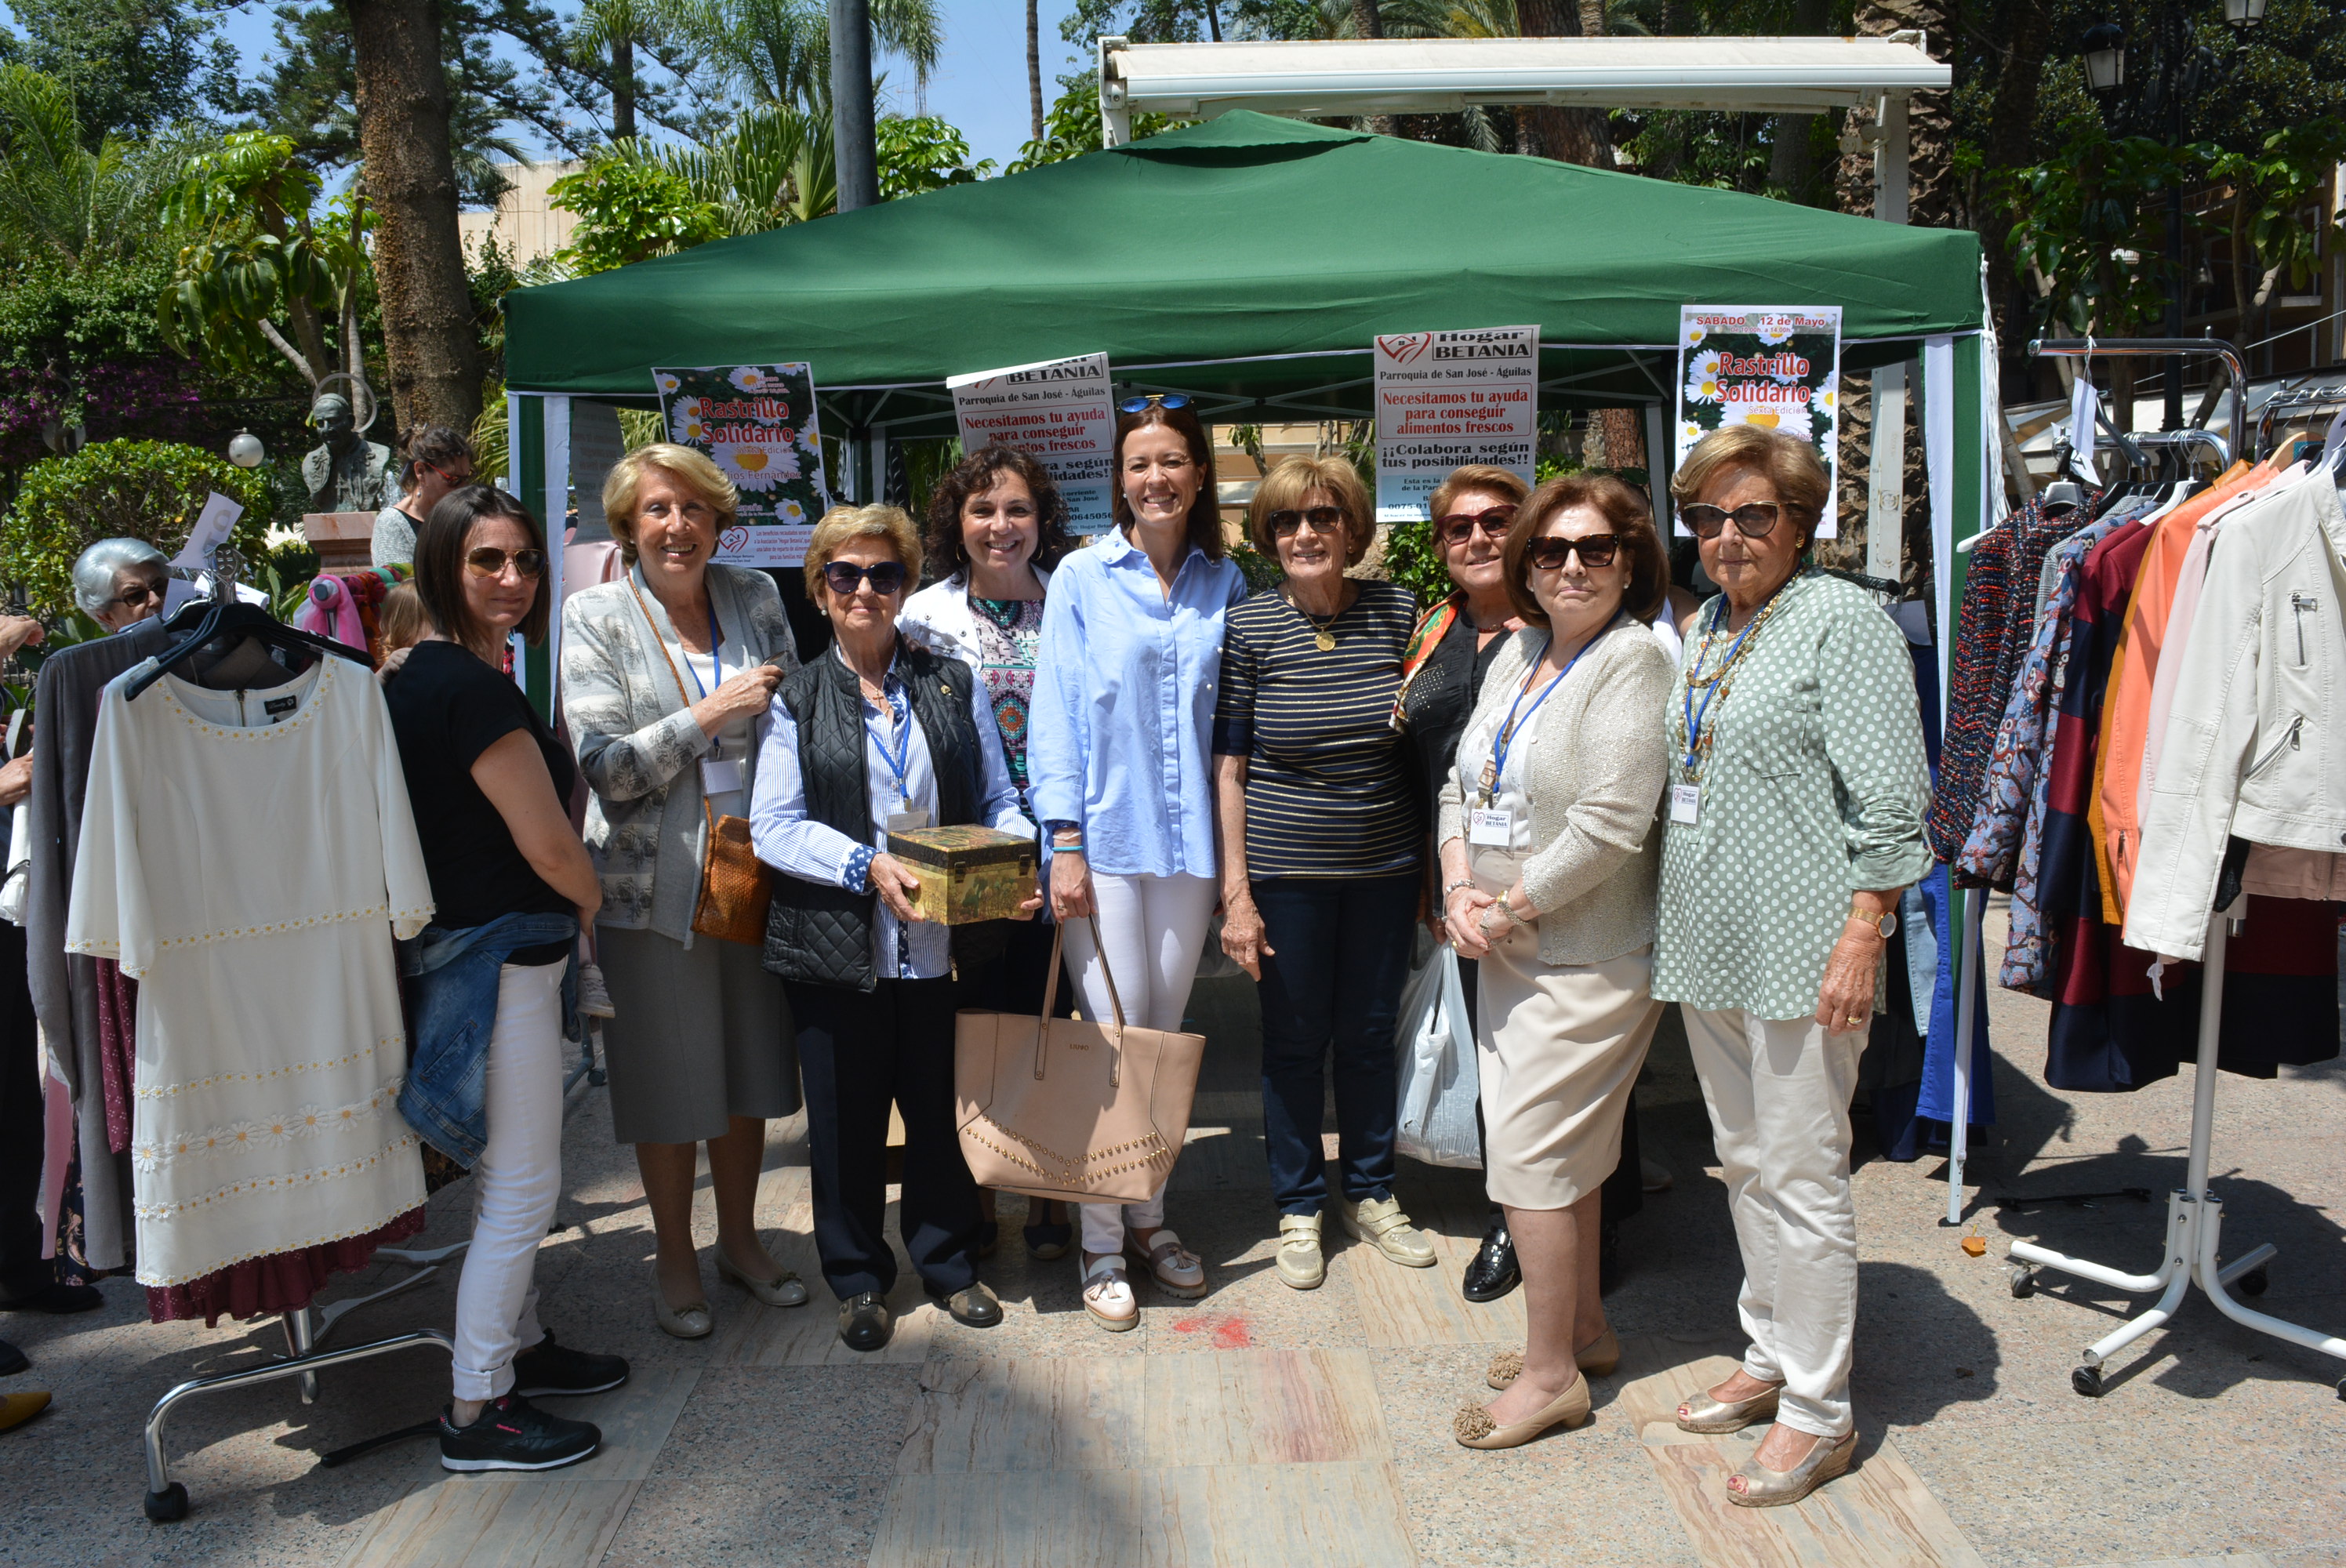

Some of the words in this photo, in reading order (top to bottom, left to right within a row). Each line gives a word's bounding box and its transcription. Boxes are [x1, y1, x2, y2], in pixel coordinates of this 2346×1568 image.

[1760, 317, 1774, 325] 12
[1778, 317, 1791, 325] de
[1795, 317, 1825, 328] Mayo
[1440, 332, 1524, 343] Hogar
[1436, 343, 1528, 358] BETANIA
[1718, 352, 1810, 376] Rastrillo
[1009, 365, 1101, 383] BETANIA
[1380, 370, 1428, 381] Parroquia
[1431, 369, 1443, 379] de
[1446, 368, 1463, 379] San
[1466, 368, 1487, 378] José
[1496, 365, 1532, 378] Águilas
[958, 394, 1006, 405] Parroquia
[1008, 393, 1019, 402] de
[1022, 390, 1040, 401] San
[1042, 389, 1063, 400] José
[1071, 386, 1106, 398] Águilas
[1383, 391, 1467, 405] Necesitamos
[1471, 391, 1484, 403] tu
[1488, 389, 1528, 405] ayuda
[1715, 378, 1811, 403] Solidario
[699, 397, 789, 418] Rastrillo
[1405, 408, 1436, 421] para
[1440, 404, 1506, 420] conseguir
[1775, 405, 1807, 414] Edición
[964, 414, 1046, 430] Necesitamos
[1050, 412, 1062, 423] tu
[1067, 408, 1106, 424] ayuda
[701, 423, 795, 444] Solidario
[989, 430, 1019, 442] para
[1022, 422, 1086, 440] conseguir
[1396, 422, 1462, 434] alimentos
[1465, 421, 1514, 433] frescos
[1049, 439, 1096, 452] frescos
[1382, 444, 1472, 457] ¡¡Colabora
[1479, 441, 1529, 455] según
[1066, 458, 1113, 470] según
[1382, 457, 1407, 468] tus
[1411, 454, 1528, 469] posibilidades!!
[748, 470, 801, 480] Fernández
